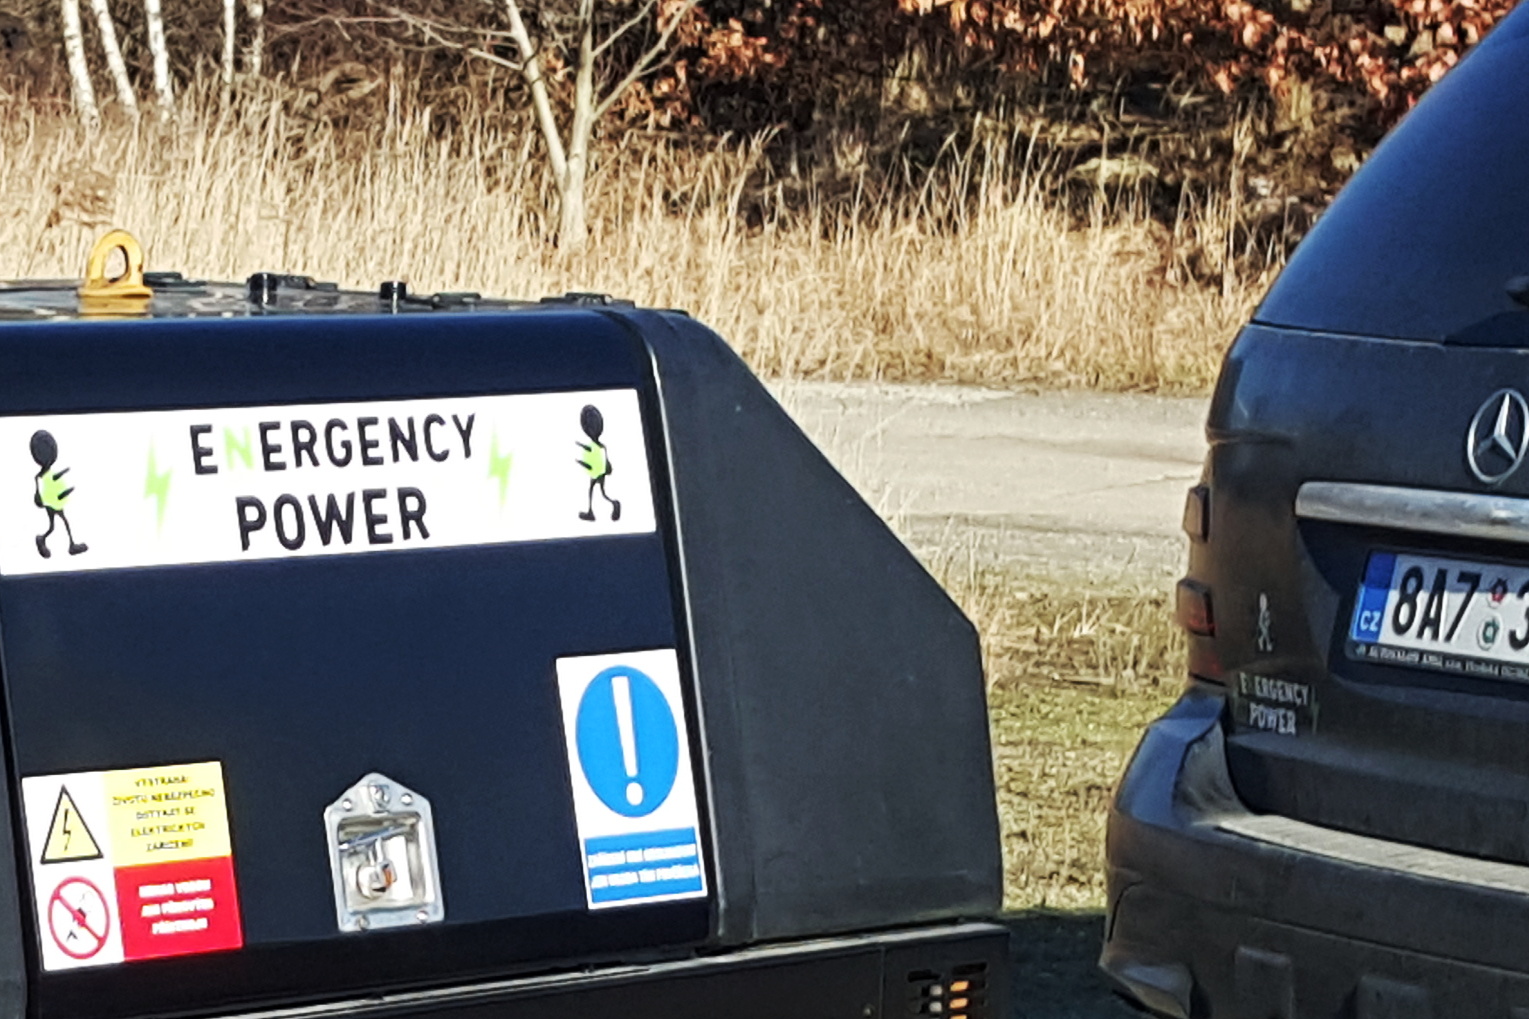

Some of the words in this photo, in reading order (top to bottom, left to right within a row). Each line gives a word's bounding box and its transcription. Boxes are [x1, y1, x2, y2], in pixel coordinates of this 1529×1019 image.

[189, 413, 477, 476] ENERGENCY
[236, 486, 431, 552] POWER
[1359, 610, 1381, 632] CZ
[1391, 565, 1482, 644] 8A7
[1239, 671, 1309, 707] EERGENCY
[1249, 701, 1296, 736] POWER
